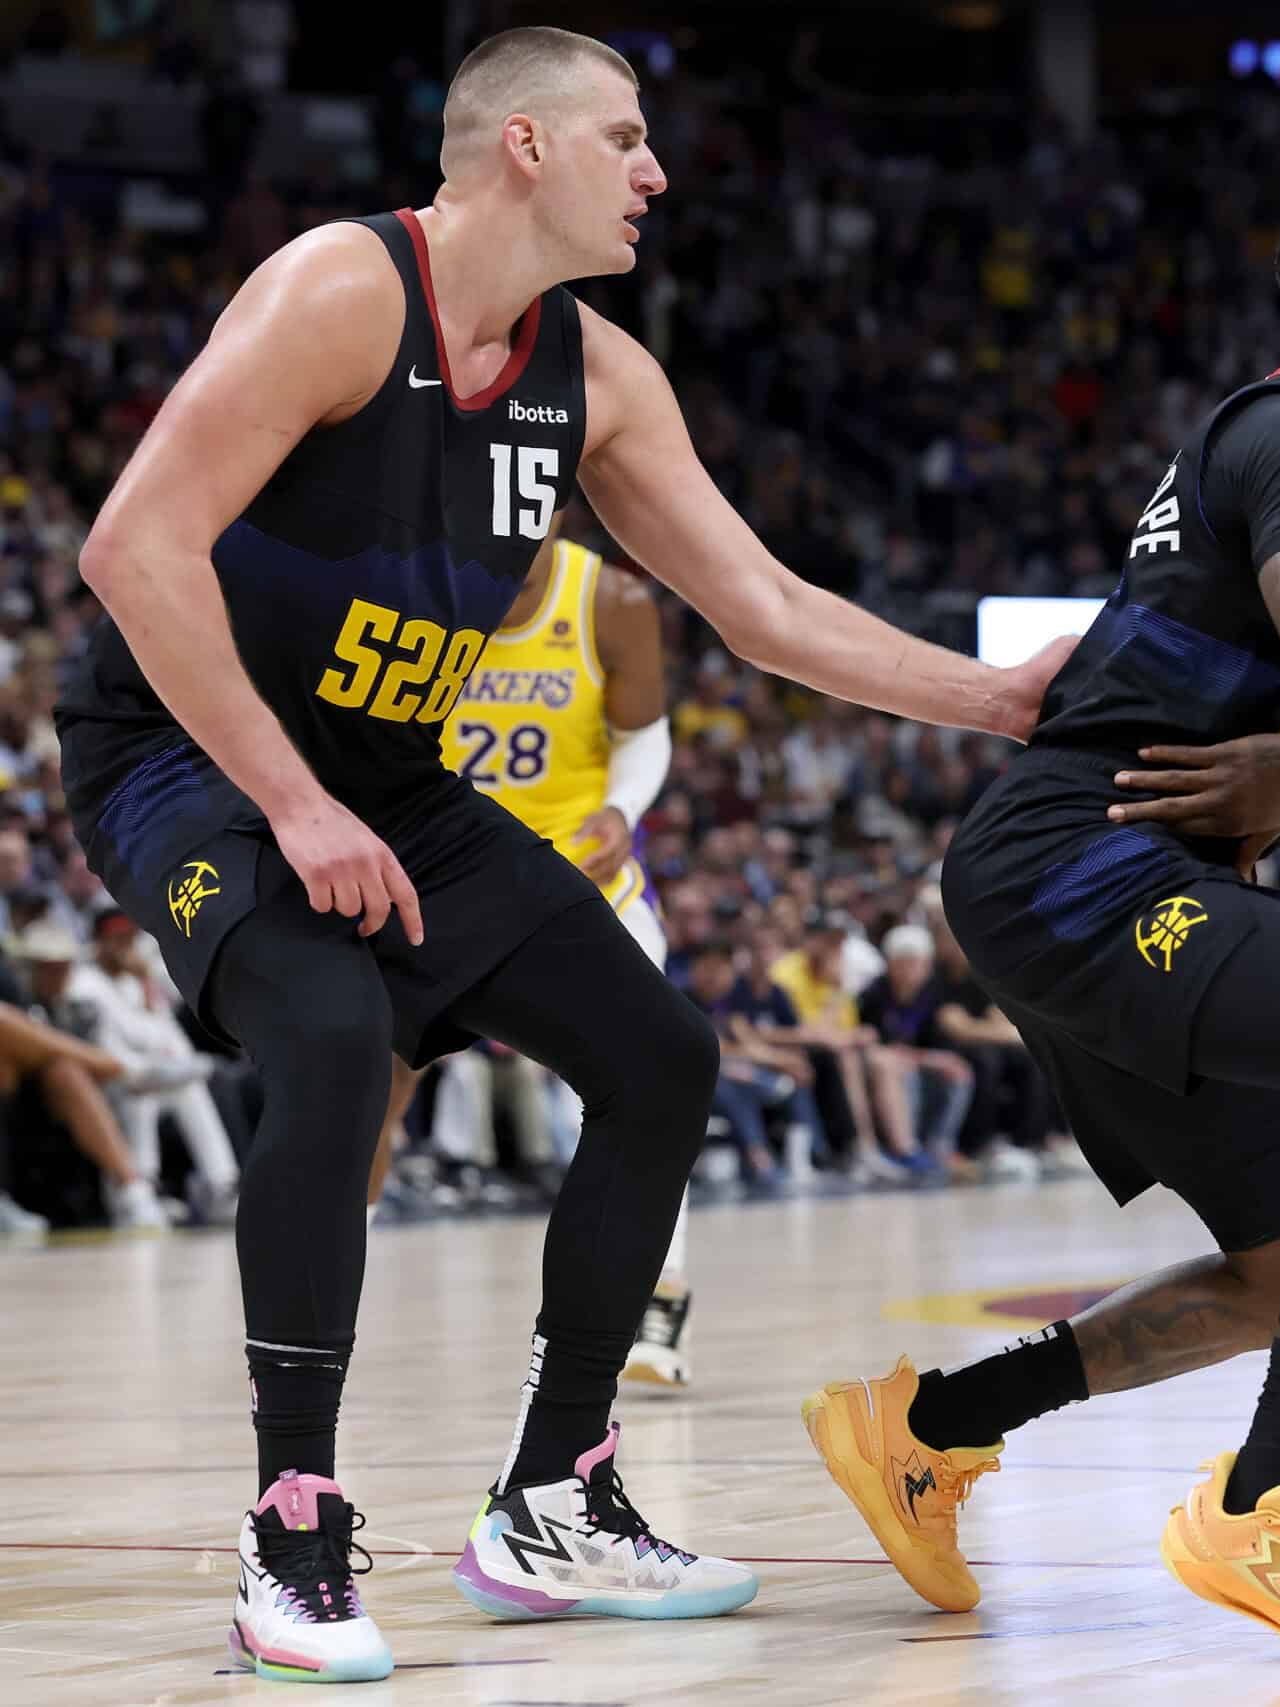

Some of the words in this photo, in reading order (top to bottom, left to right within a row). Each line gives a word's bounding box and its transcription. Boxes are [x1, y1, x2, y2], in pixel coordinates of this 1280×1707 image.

[508, 400, 569, 424] ibotta
[489, 443, 559, 540] 15
[315, 597, 486, 724] 528
[457, 668, 577, 710] AKERS
[457, 722, 548, 784] 28
